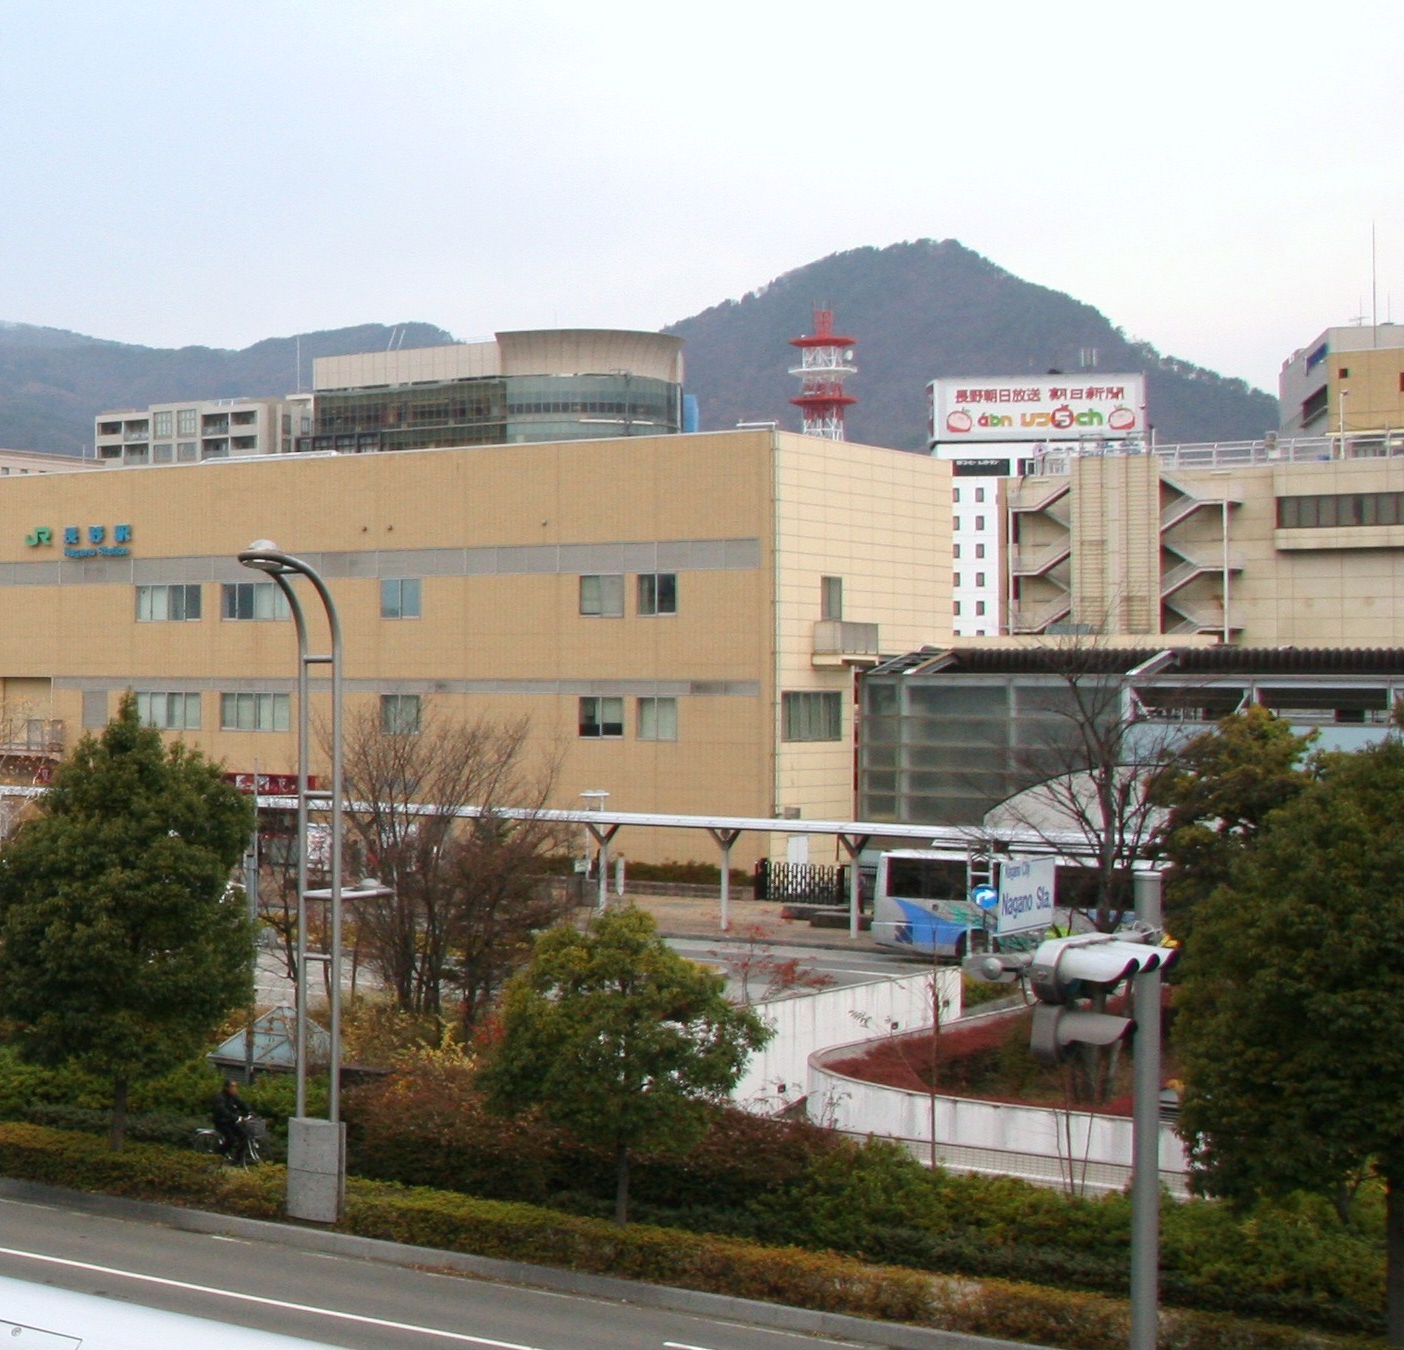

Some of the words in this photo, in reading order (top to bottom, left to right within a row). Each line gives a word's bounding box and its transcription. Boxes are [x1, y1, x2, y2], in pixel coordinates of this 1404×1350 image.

[955, 388, 1041, 403] 長野朝日放送
[1049, 386, 1125, 401] 朝日新聞
[24, 526, 53, 547] JR
[1001, 892, 1033, 919] Nagano
